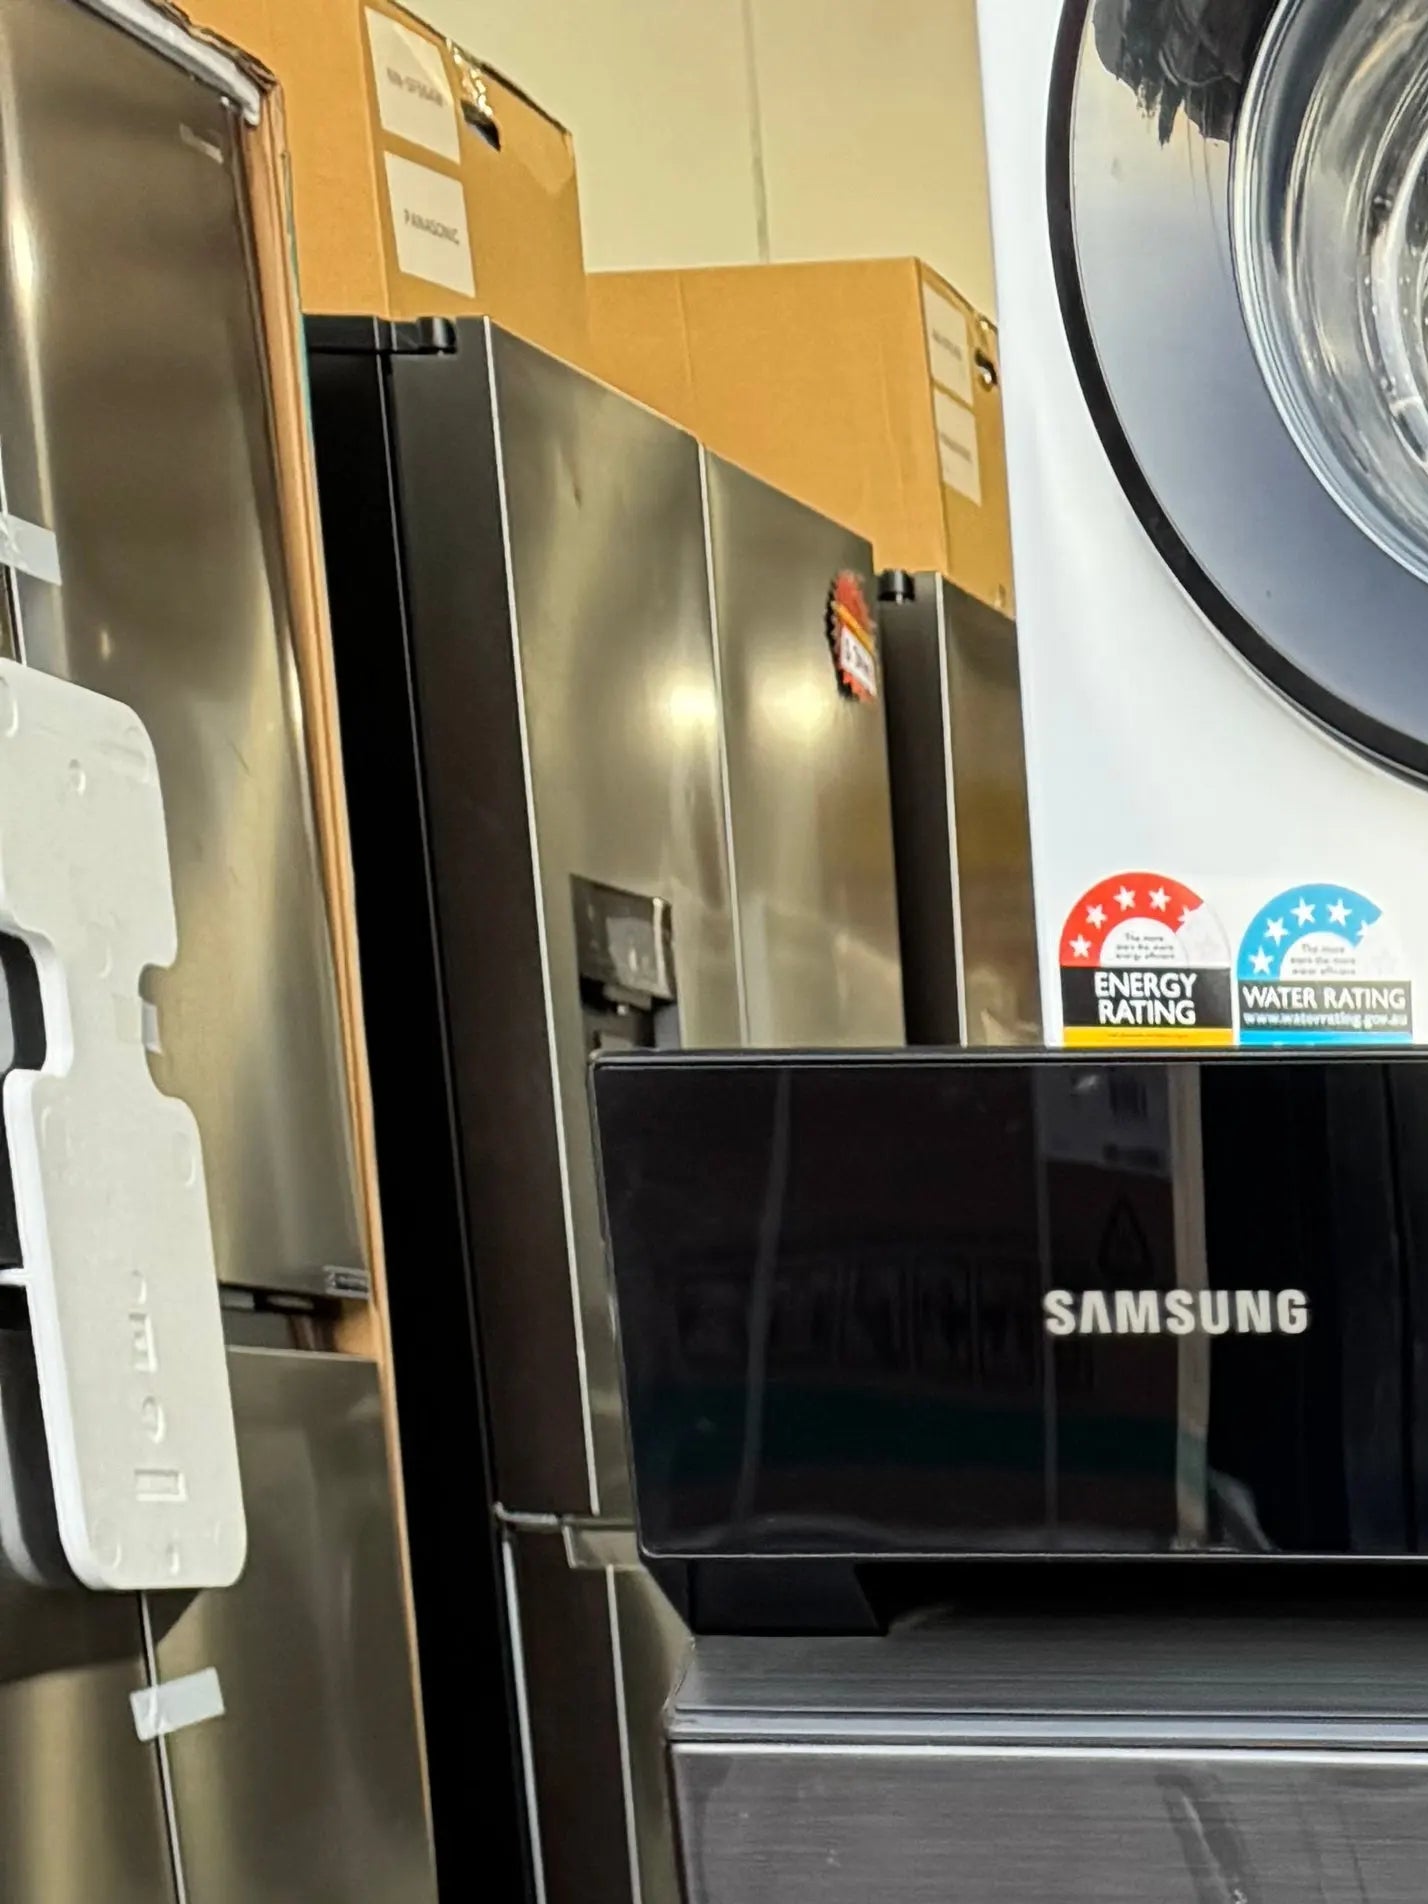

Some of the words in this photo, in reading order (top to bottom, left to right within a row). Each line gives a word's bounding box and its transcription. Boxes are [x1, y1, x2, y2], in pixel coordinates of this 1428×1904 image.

[1094, 971, 1197, 999] ENERGY
[1242, 986, 1317, 1009] WATER
[1323, 987, 1406, 1010] RATING
[1098, 999, 1196, 1025] RATING
[1043, 1289, 1309, 1335] SAMSUNG
